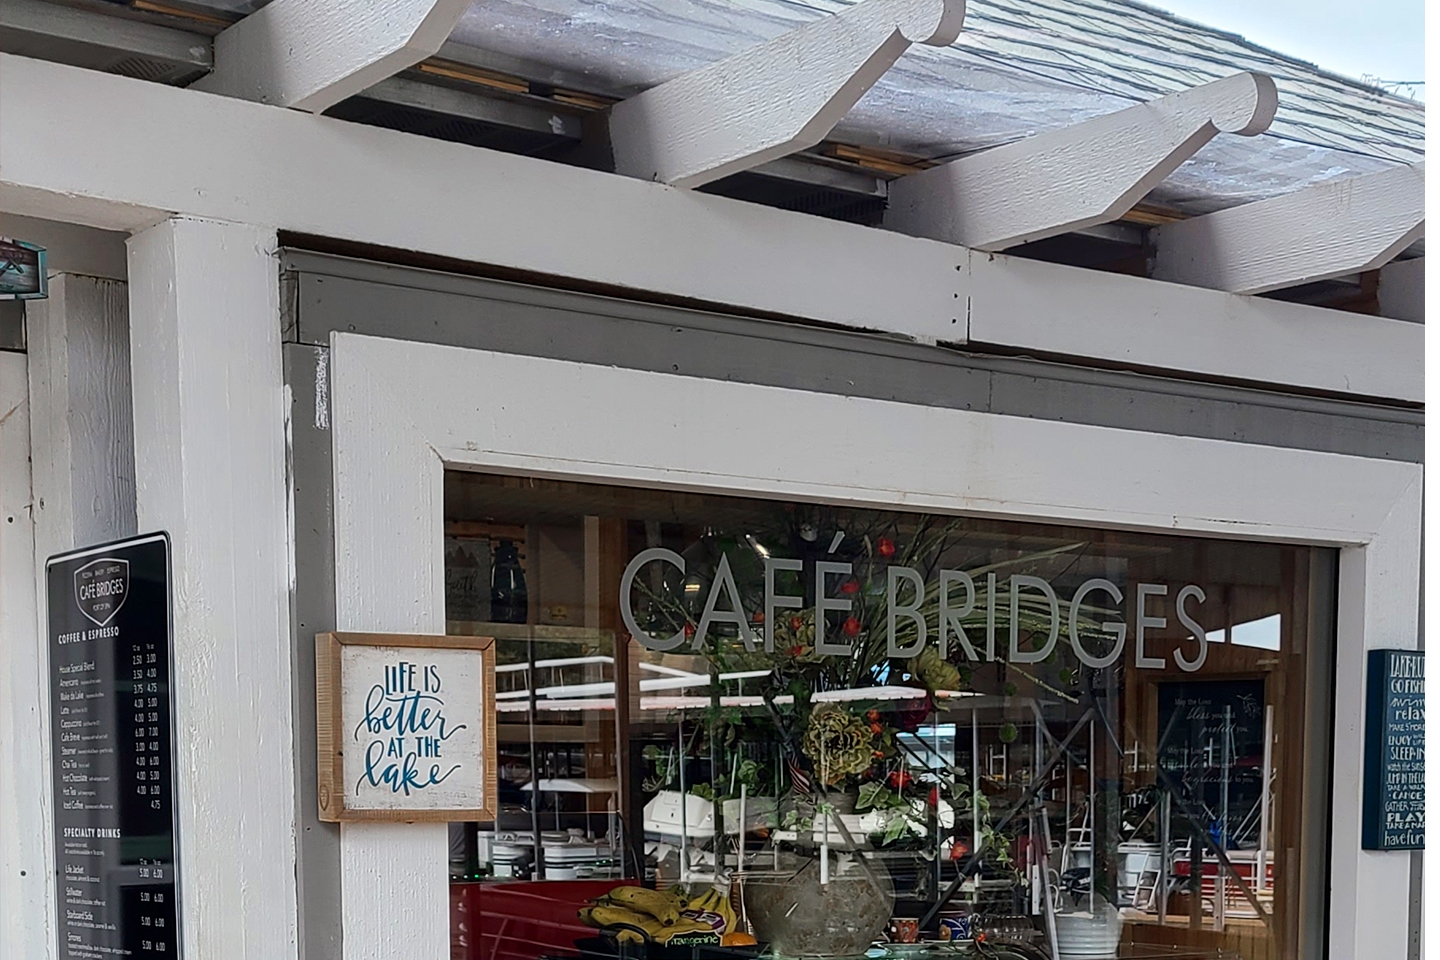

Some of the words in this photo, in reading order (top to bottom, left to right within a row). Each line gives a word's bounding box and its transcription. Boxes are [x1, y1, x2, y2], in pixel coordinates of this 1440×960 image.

[80, 580, 96, 600] CAFÉ
[97, 578, 123, 597] BRIDGES
[619, 530, 854, 656] CAFÉ
[885, 565, 1210, 674] BRIDGES
[58, 632, 80, 645] COFFEE
[82, 631, 87, 641] &
[88, 626, 119, 640] ESPRESSO
[147, 682, 157, 692] 4.75
[384, 661, 417, 696] LIFE
[424, 664, 442, 694] IS
[354, 684, 467, 741] better
[387, 737, 406, 760] AT
[415, 736, 443, 759] THE
[356, 739, 462, 797] lake
[1387, 812, 1425, 822] PLAY
[63, 827, 96, 838] SPECIALTY
[97, 828, 121, 839] DRINKS
[1384, 830, 1406, 847] have
